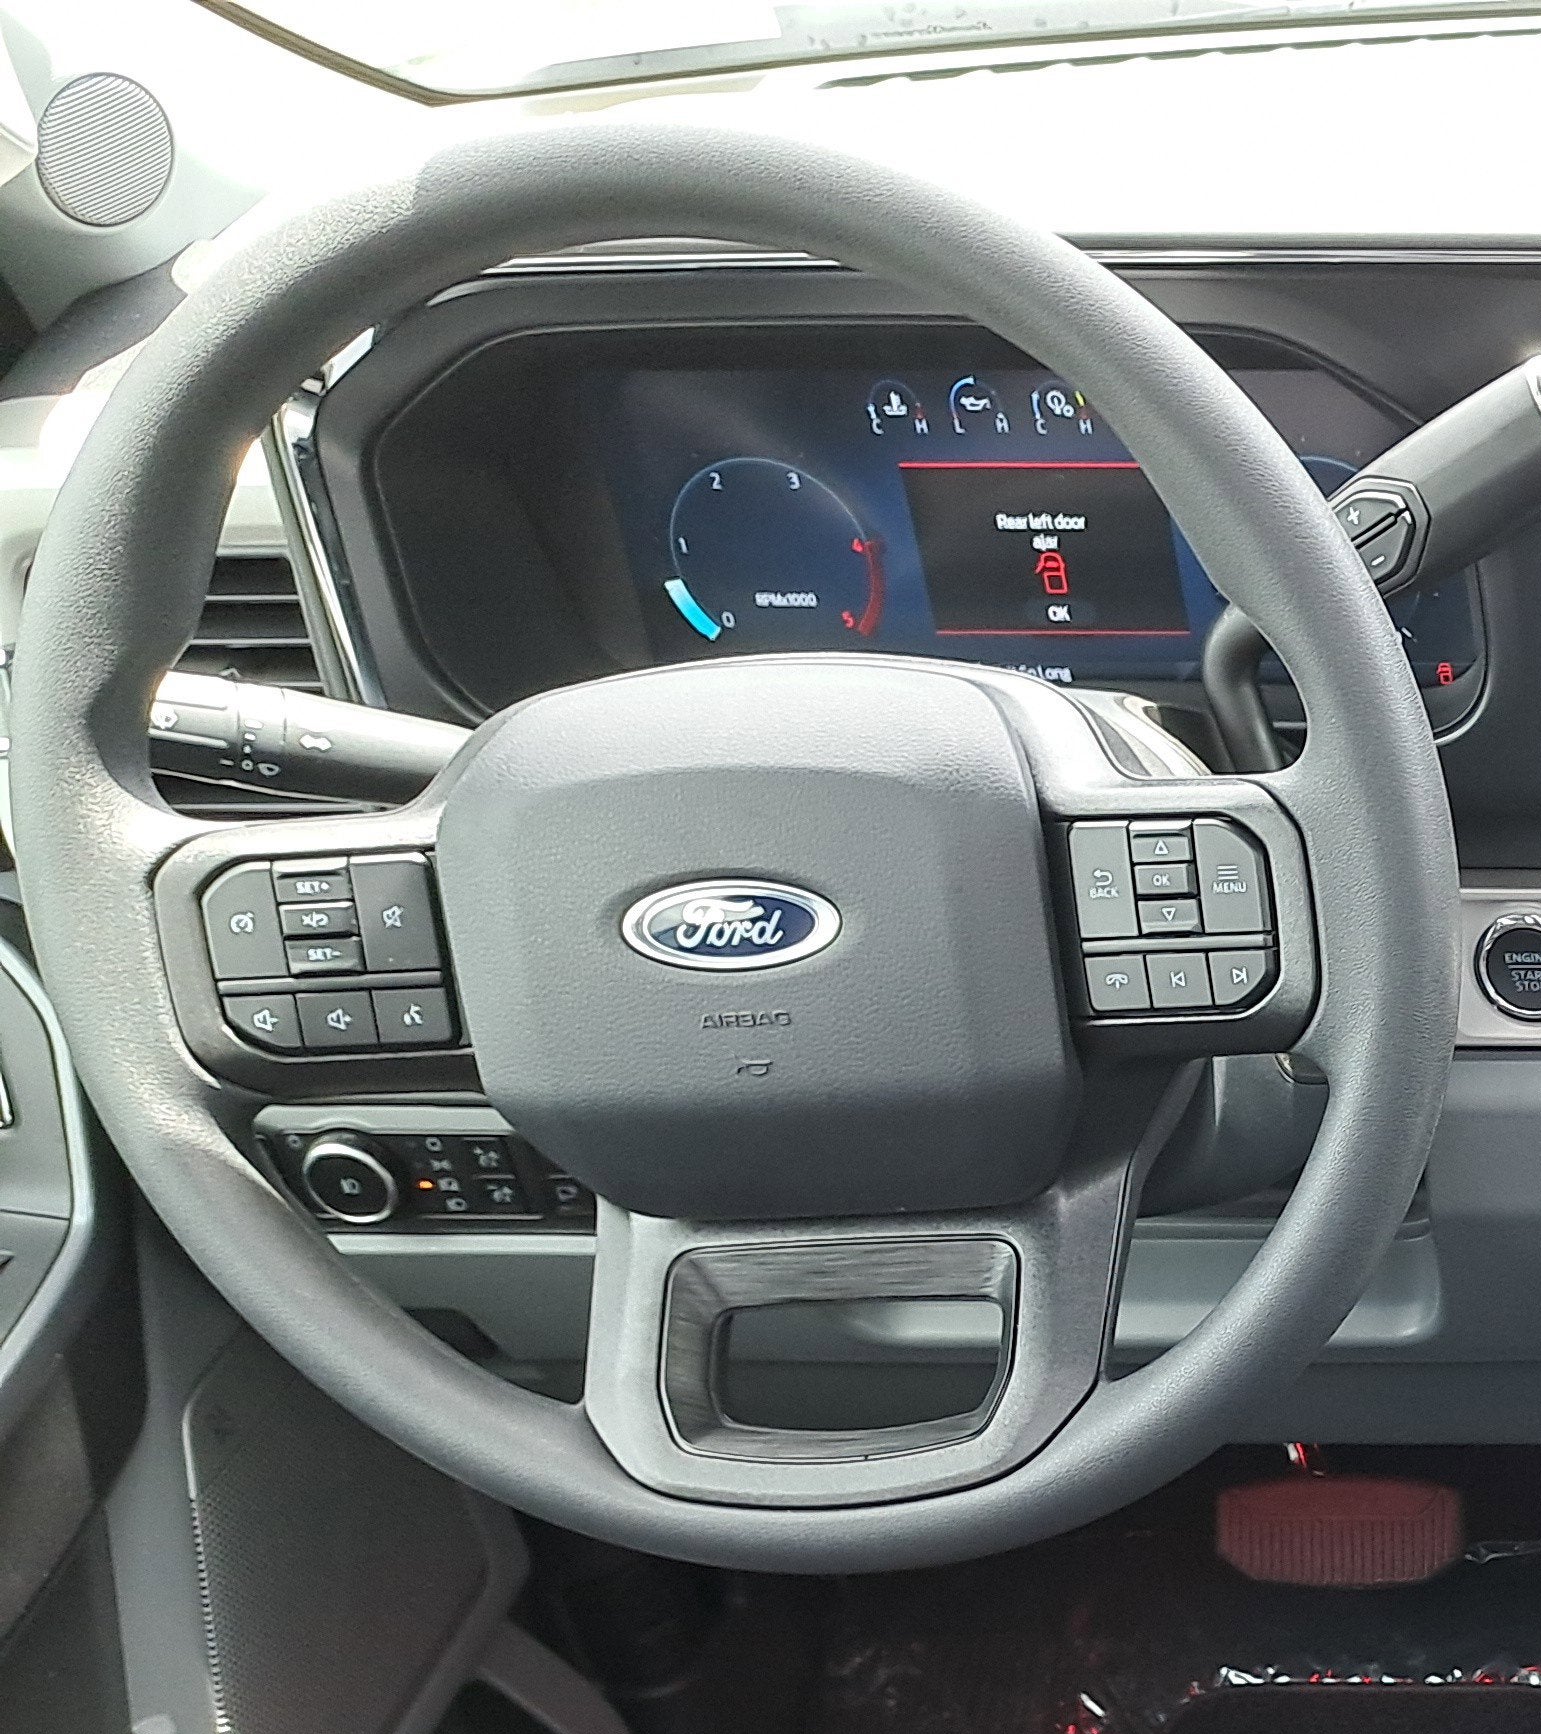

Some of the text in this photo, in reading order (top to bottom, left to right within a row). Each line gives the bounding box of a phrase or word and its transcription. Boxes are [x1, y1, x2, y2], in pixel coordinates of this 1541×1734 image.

[709, 471, 723, 491] 2
[786, 471, 801, 491] 3
[995, 512, 1086, 530] Rear left door
[678, 537, 689, 554] 1
[721, 611, 736, 629] 0
[842, 610, 856, 629] 5
[1047, 604, 1071, 622] OK
[1152, 873, 1171, 887] OK
[1212, 881, 1247, 894] MENU
[1089, 886, 1120, 899] BACK
[676, 898, 786, 949] Ford
[701, 1010, 792, 1029] AIRBAG
